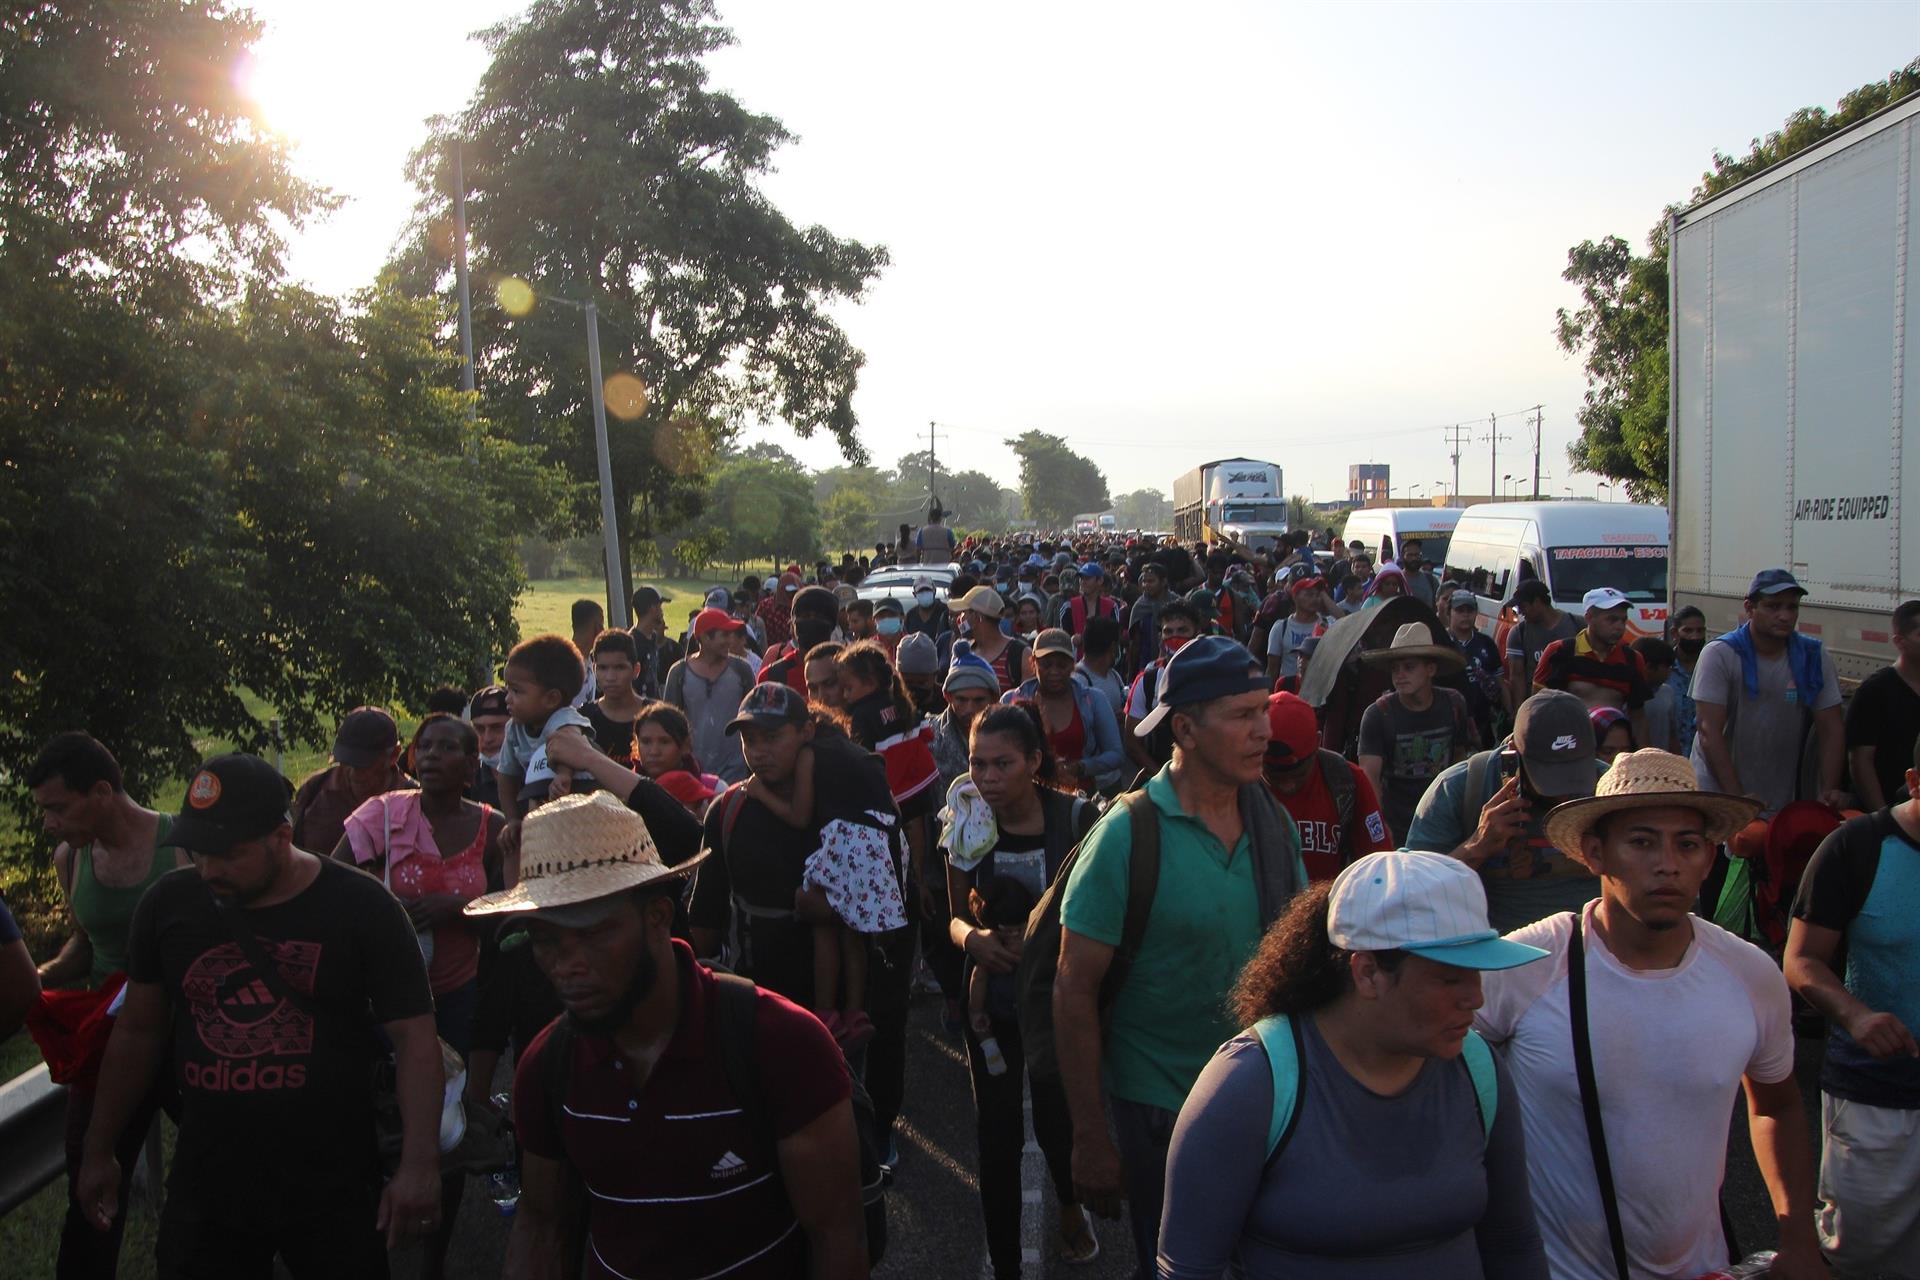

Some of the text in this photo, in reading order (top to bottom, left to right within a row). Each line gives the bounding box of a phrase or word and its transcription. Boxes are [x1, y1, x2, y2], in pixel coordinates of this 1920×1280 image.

[1794, 494, 1889, 521] AIR-RIDE EQUIPPED
[185, 1059, 307, 1092] adidas
